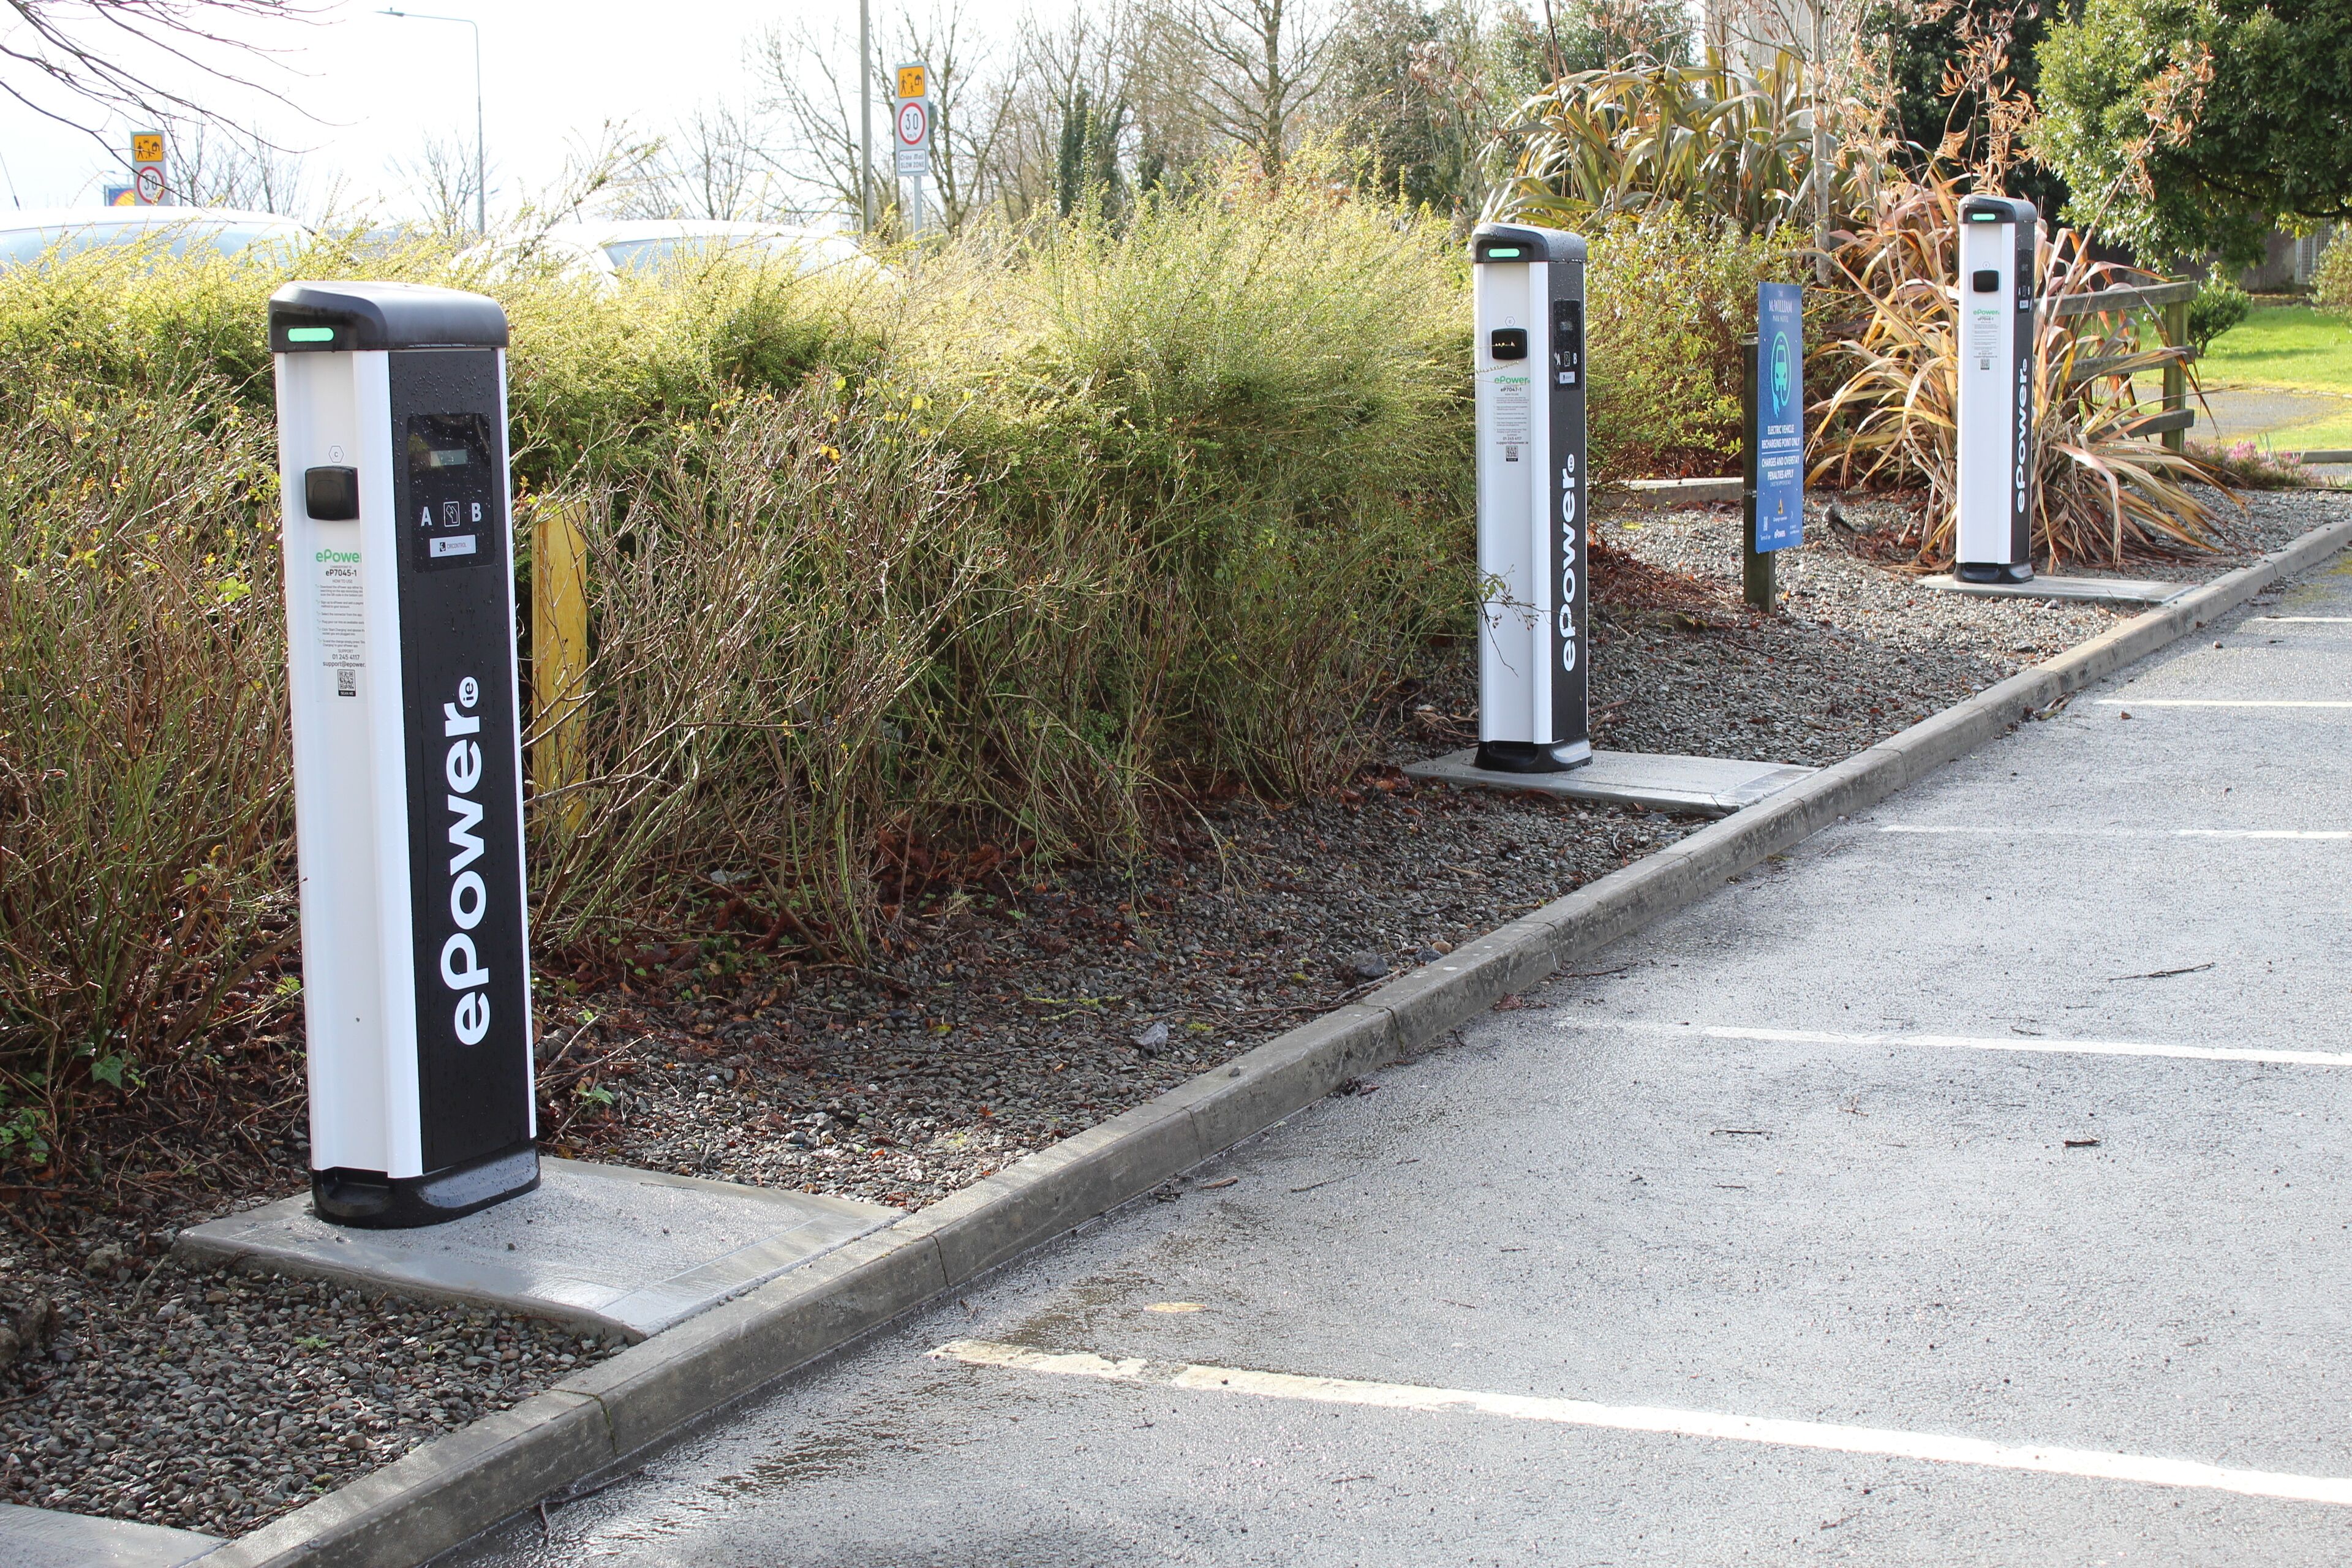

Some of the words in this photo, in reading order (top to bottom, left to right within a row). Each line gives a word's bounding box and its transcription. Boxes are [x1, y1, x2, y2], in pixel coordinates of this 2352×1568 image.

[905, 113, 918, 130] 30
[1557, 353, 1561, 365] A
[1573, 352, 1577, 364] B
[1494, 375, 1528, 384] ePower
[1767, 424, 1782, 435] ELECTRIC
[1782, 424, 1794, 434] VEHICLE
[1762, 438, 1782, 449] RECHARGING
[1782, 437, 1791, 448] POINT
[1792, 437, 1800, 447] ONLY
[2016, 369, 2027, 513] ePower
[1762, 457, 1776, 467] CHARGES
[1784, 455, 1800, 466] OVERSTAY
[1767, 470, 1784, 481] PENALTIES
[1784, 469, 1794, 478] APPLY
[421, 507, 432, 527] A
[471, 502, 482, 522] B
[1559, 468, 1576, 672] ePower
[463, 682, 474, 701] ie
[440, 702, 490, 1046] ePower
